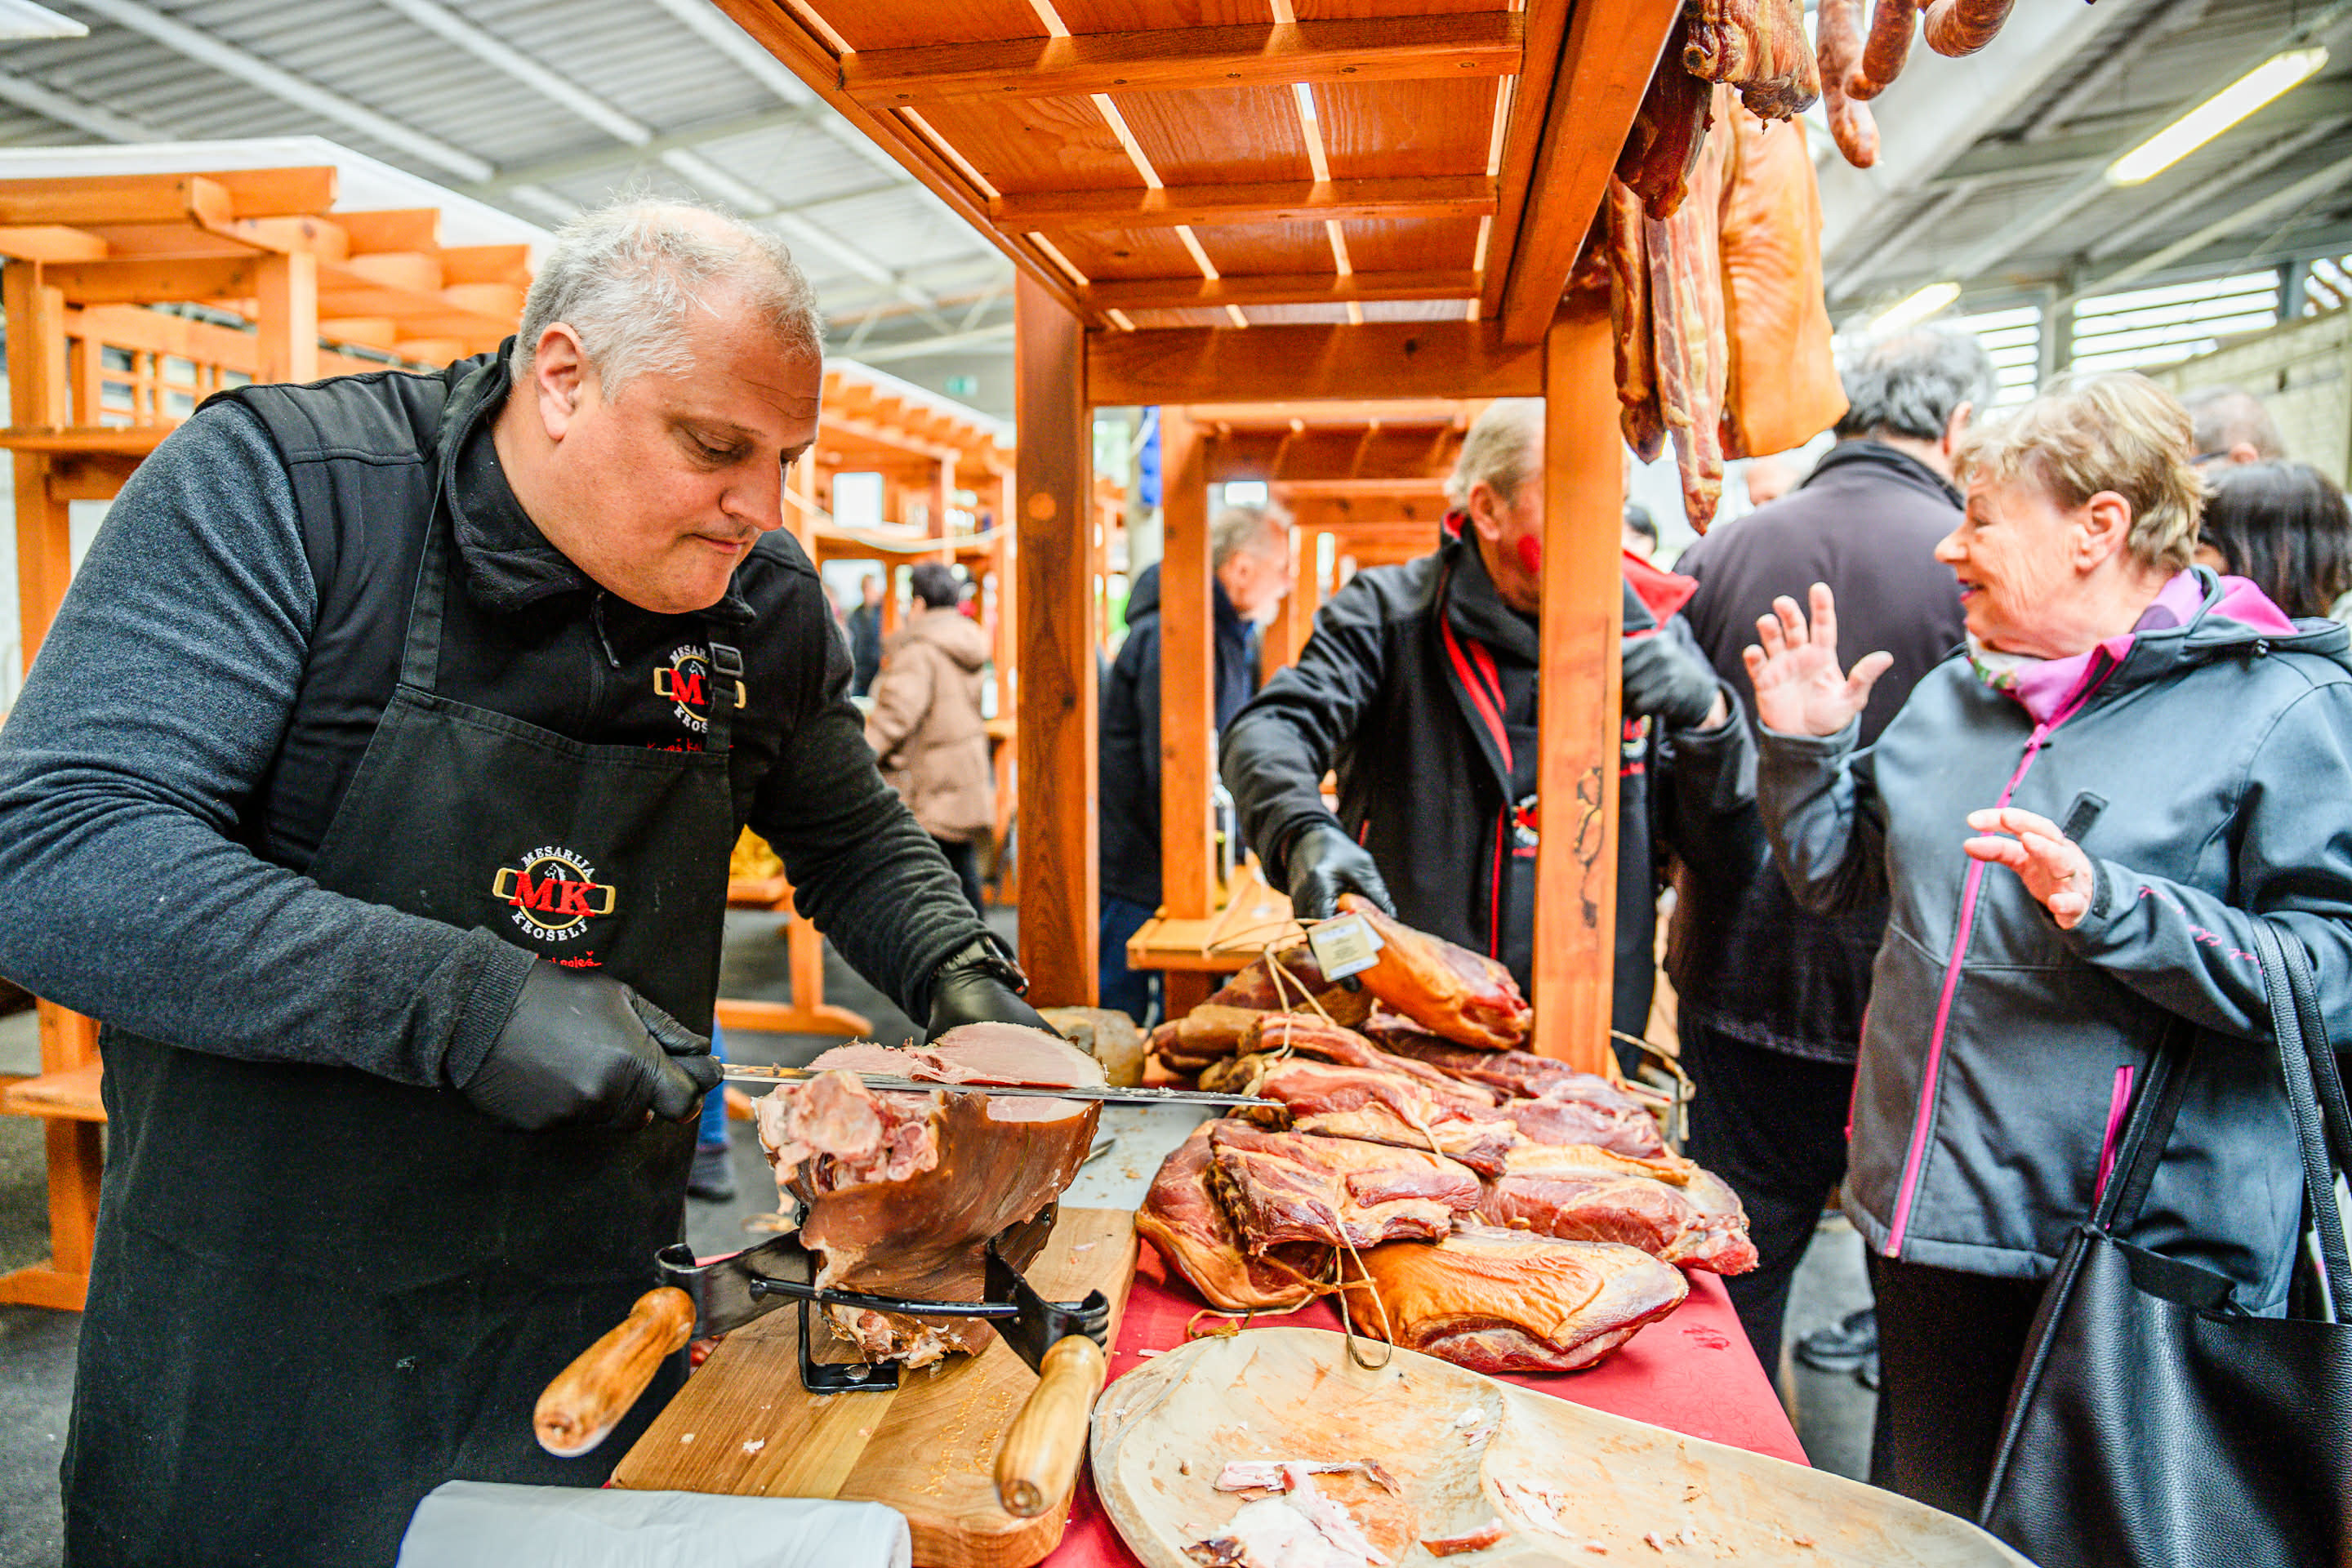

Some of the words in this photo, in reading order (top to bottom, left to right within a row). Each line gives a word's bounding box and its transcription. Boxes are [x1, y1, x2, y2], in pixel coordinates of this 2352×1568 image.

[669, 668, 709, 705] M
[521, 846, 595, 879] MESARIJA
[509, 870, 597, 917] MK
